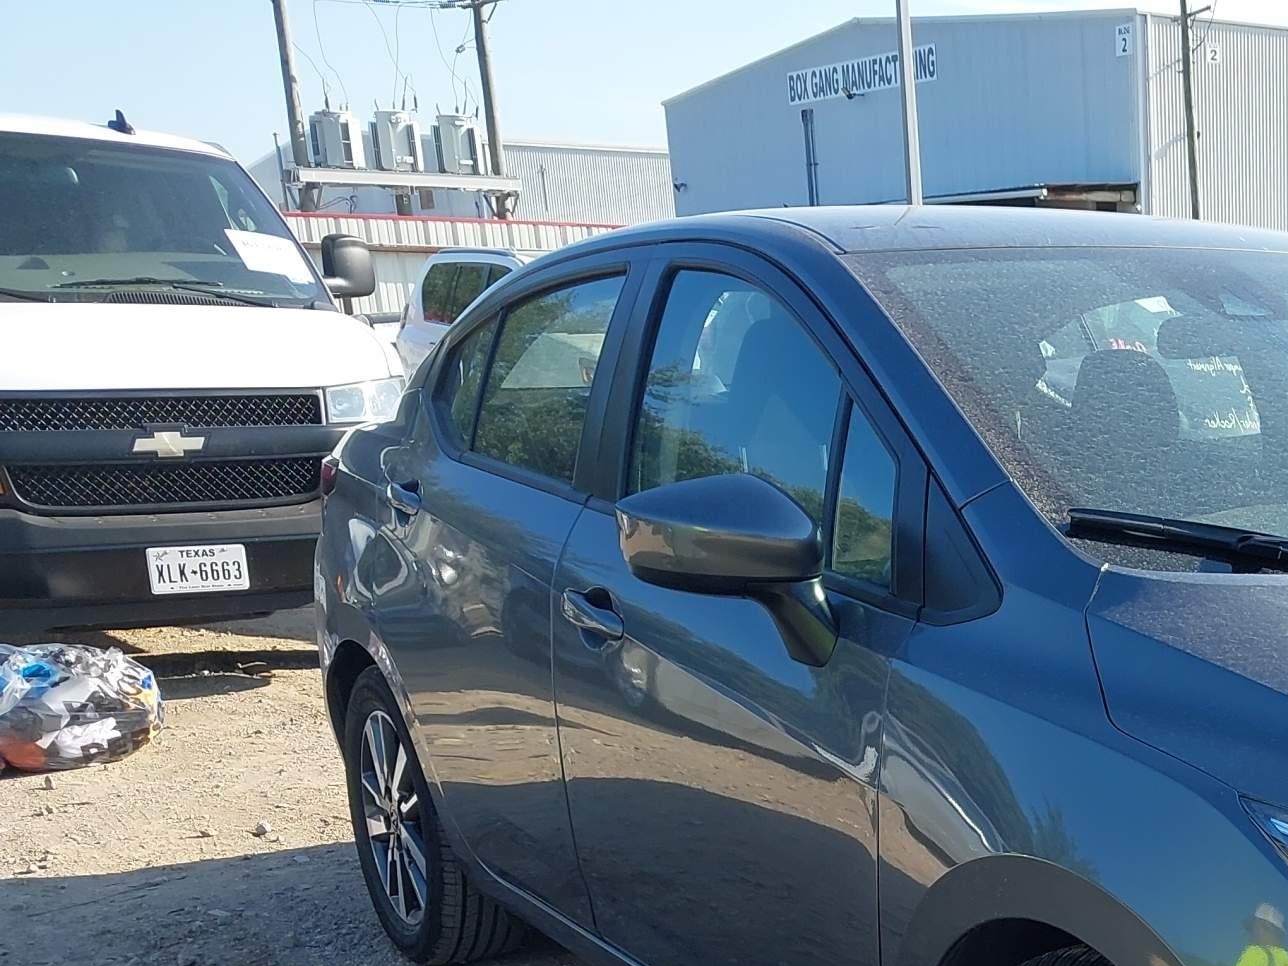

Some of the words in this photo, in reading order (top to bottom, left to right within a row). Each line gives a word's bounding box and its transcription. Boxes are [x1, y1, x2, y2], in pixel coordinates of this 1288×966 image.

[1121, 37, 1128, 53] 2
[1210, 49, 1218, 61] 2
[787, 72, 810, 103] BOX
[811, 67, 840, 99] GANG
[840, 46, 936, 94] MANUFACTING
[178, 548, 215, 558] TEXAS
